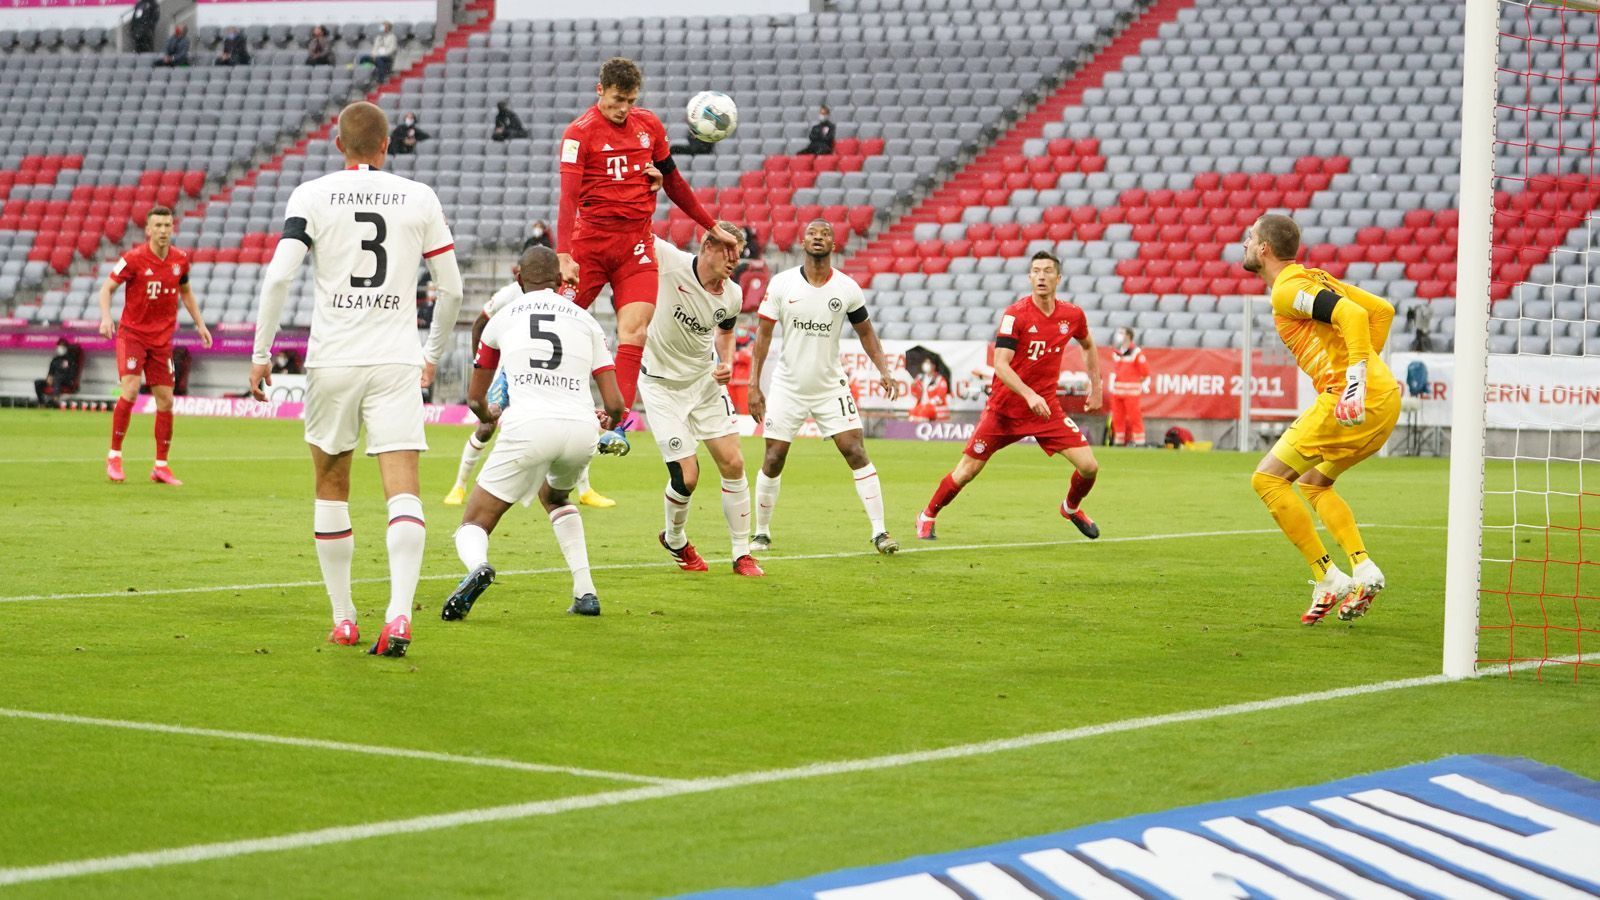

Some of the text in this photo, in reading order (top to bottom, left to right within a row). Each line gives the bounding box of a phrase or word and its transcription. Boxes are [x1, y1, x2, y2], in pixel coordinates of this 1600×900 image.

[607, 156, 628, 181] T
[330, 193, 408, 205] FRANKFURT
[350, 212, 387, 288] 3
[147, 281, 162, 300] T
[333, 294, 401, 311] ILSANKER
[511, 302, 579, 317] FRANKFURT
[529, 314, 563, 371] 5
[1027, 341, 1046, 361] T
[513, 373, 581, 392] FERNANDES
[1155, 374, 1225, 395] IMMER
[1486, 383, 1530, 403] ERN
[173, 396, 281, 418] AGENTA SPORT
[721, 395, 736, 417] 1
[838, 395, 856, 417] 18
[915, 421, 976, 442] QATAR
[1063, 416, 1080, 433] 9
